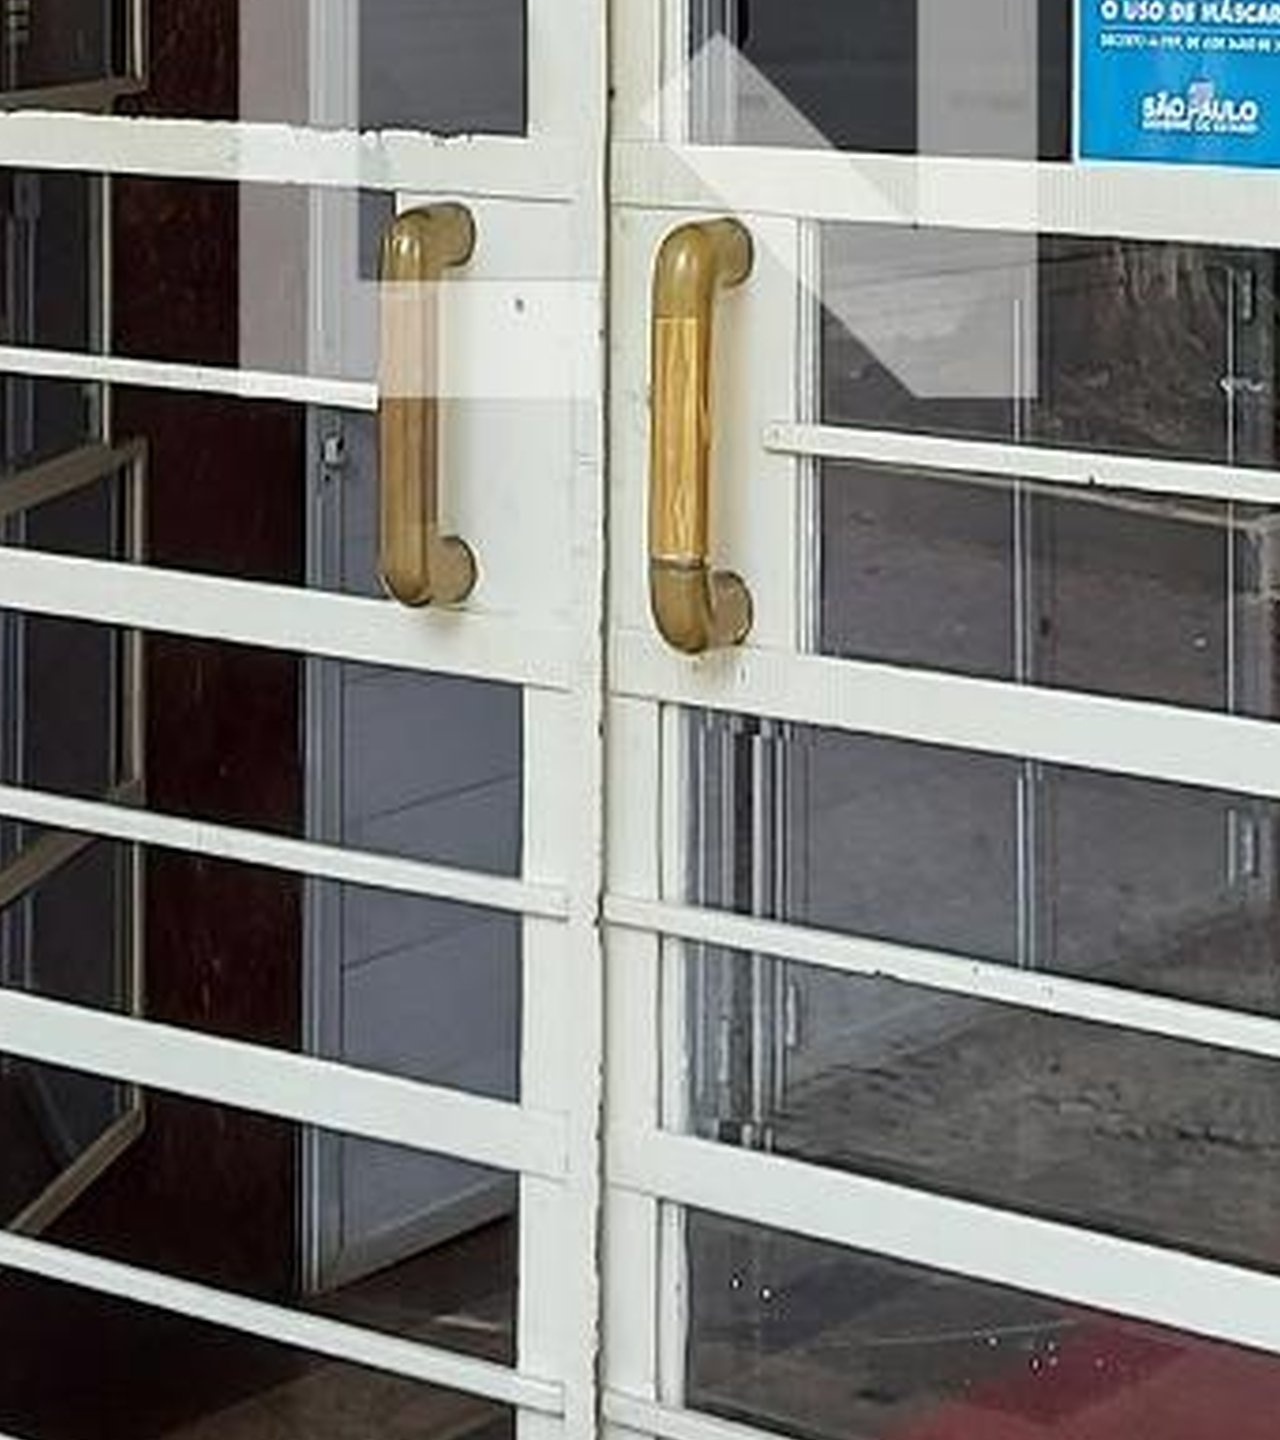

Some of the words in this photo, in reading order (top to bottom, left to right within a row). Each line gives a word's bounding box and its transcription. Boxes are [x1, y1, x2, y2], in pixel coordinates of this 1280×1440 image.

[1101, 0, 1118, 21] O
[1123, 0, 1164, 22] USO
[1169, 1, 1195, 23] DE
[1142, 89, 1185, 119] SÃO
[1187, 95, 1259, 122] PAULO
